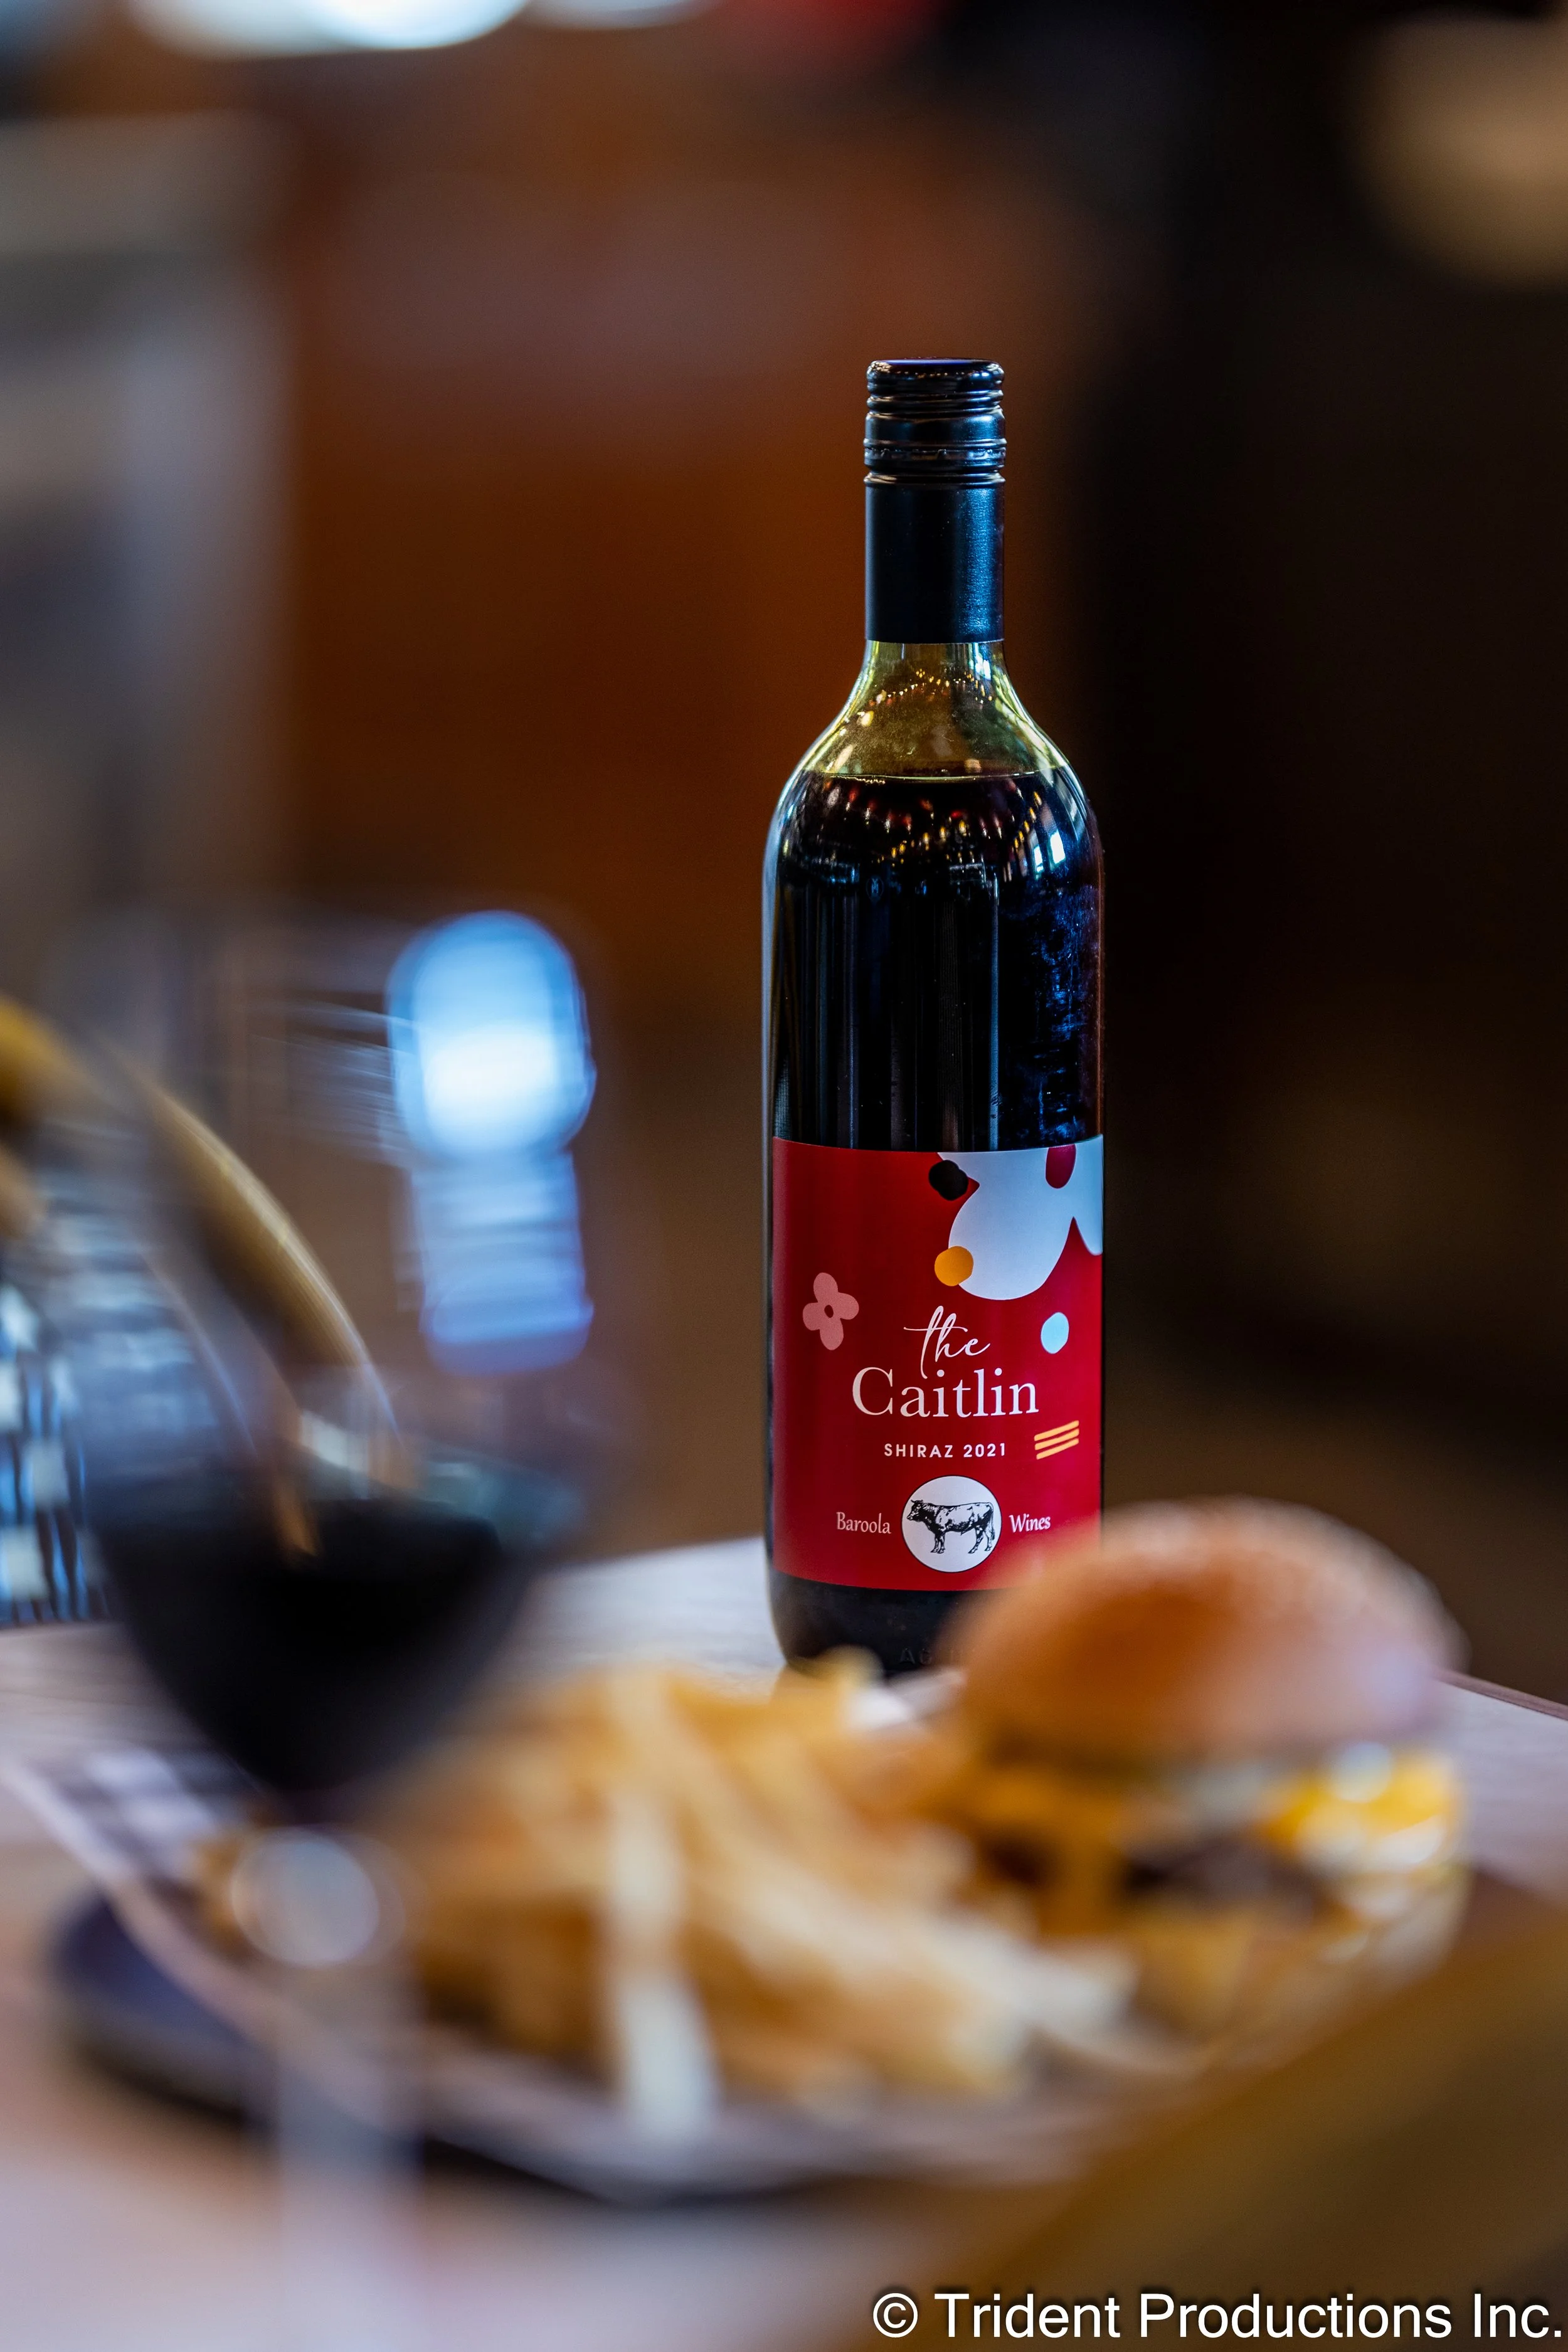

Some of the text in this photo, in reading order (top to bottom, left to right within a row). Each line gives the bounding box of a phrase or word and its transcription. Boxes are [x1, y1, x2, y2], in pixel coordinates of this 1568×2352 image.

[903, 1305, 990, 1379] the
[852, 1367, 1039, 1418] Caitlin
[884, 1443, 1006, 1458] SHIRAZ 2021
[836, 1512, 1052, 1535] Baroola Wines
